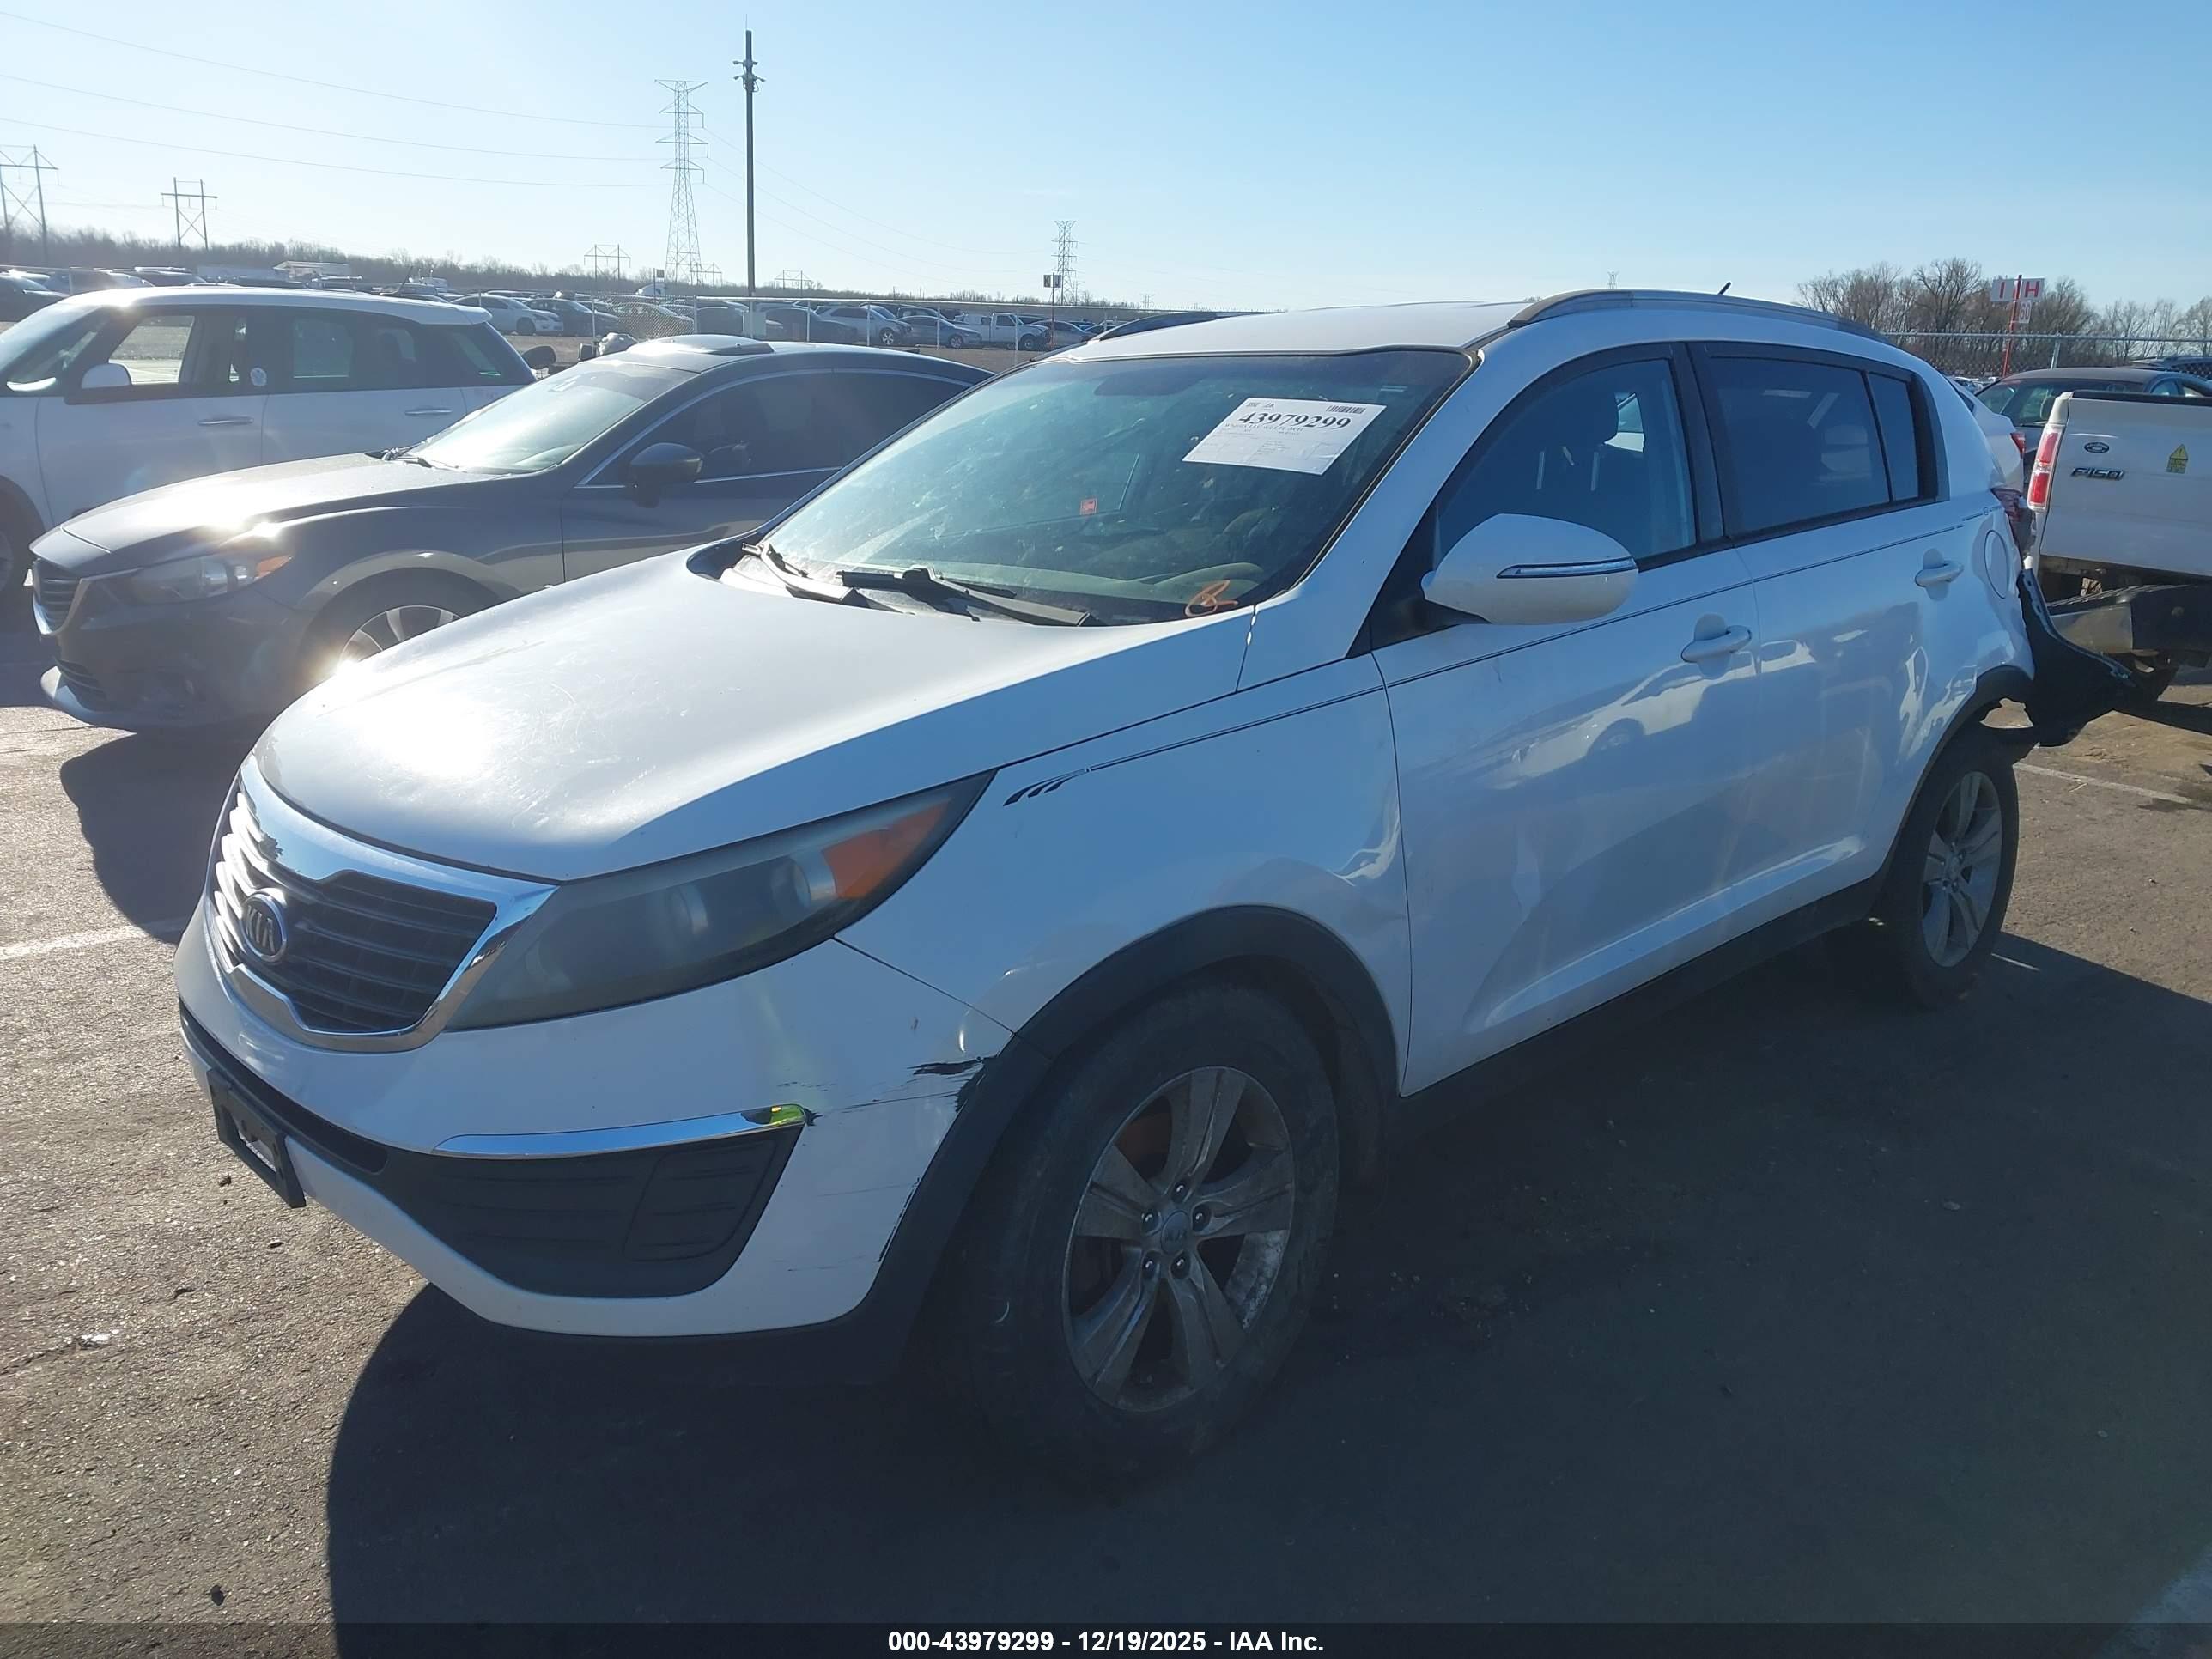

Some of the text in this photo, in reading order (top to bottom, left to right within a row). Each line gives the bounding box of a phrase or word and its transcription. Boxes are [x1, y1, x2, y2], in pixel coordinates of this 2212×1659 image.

[2024, 280, 2040, 298] H
[1238, 411, 1352, 430] 43979299
[245, 905, 276, 953] KIA
